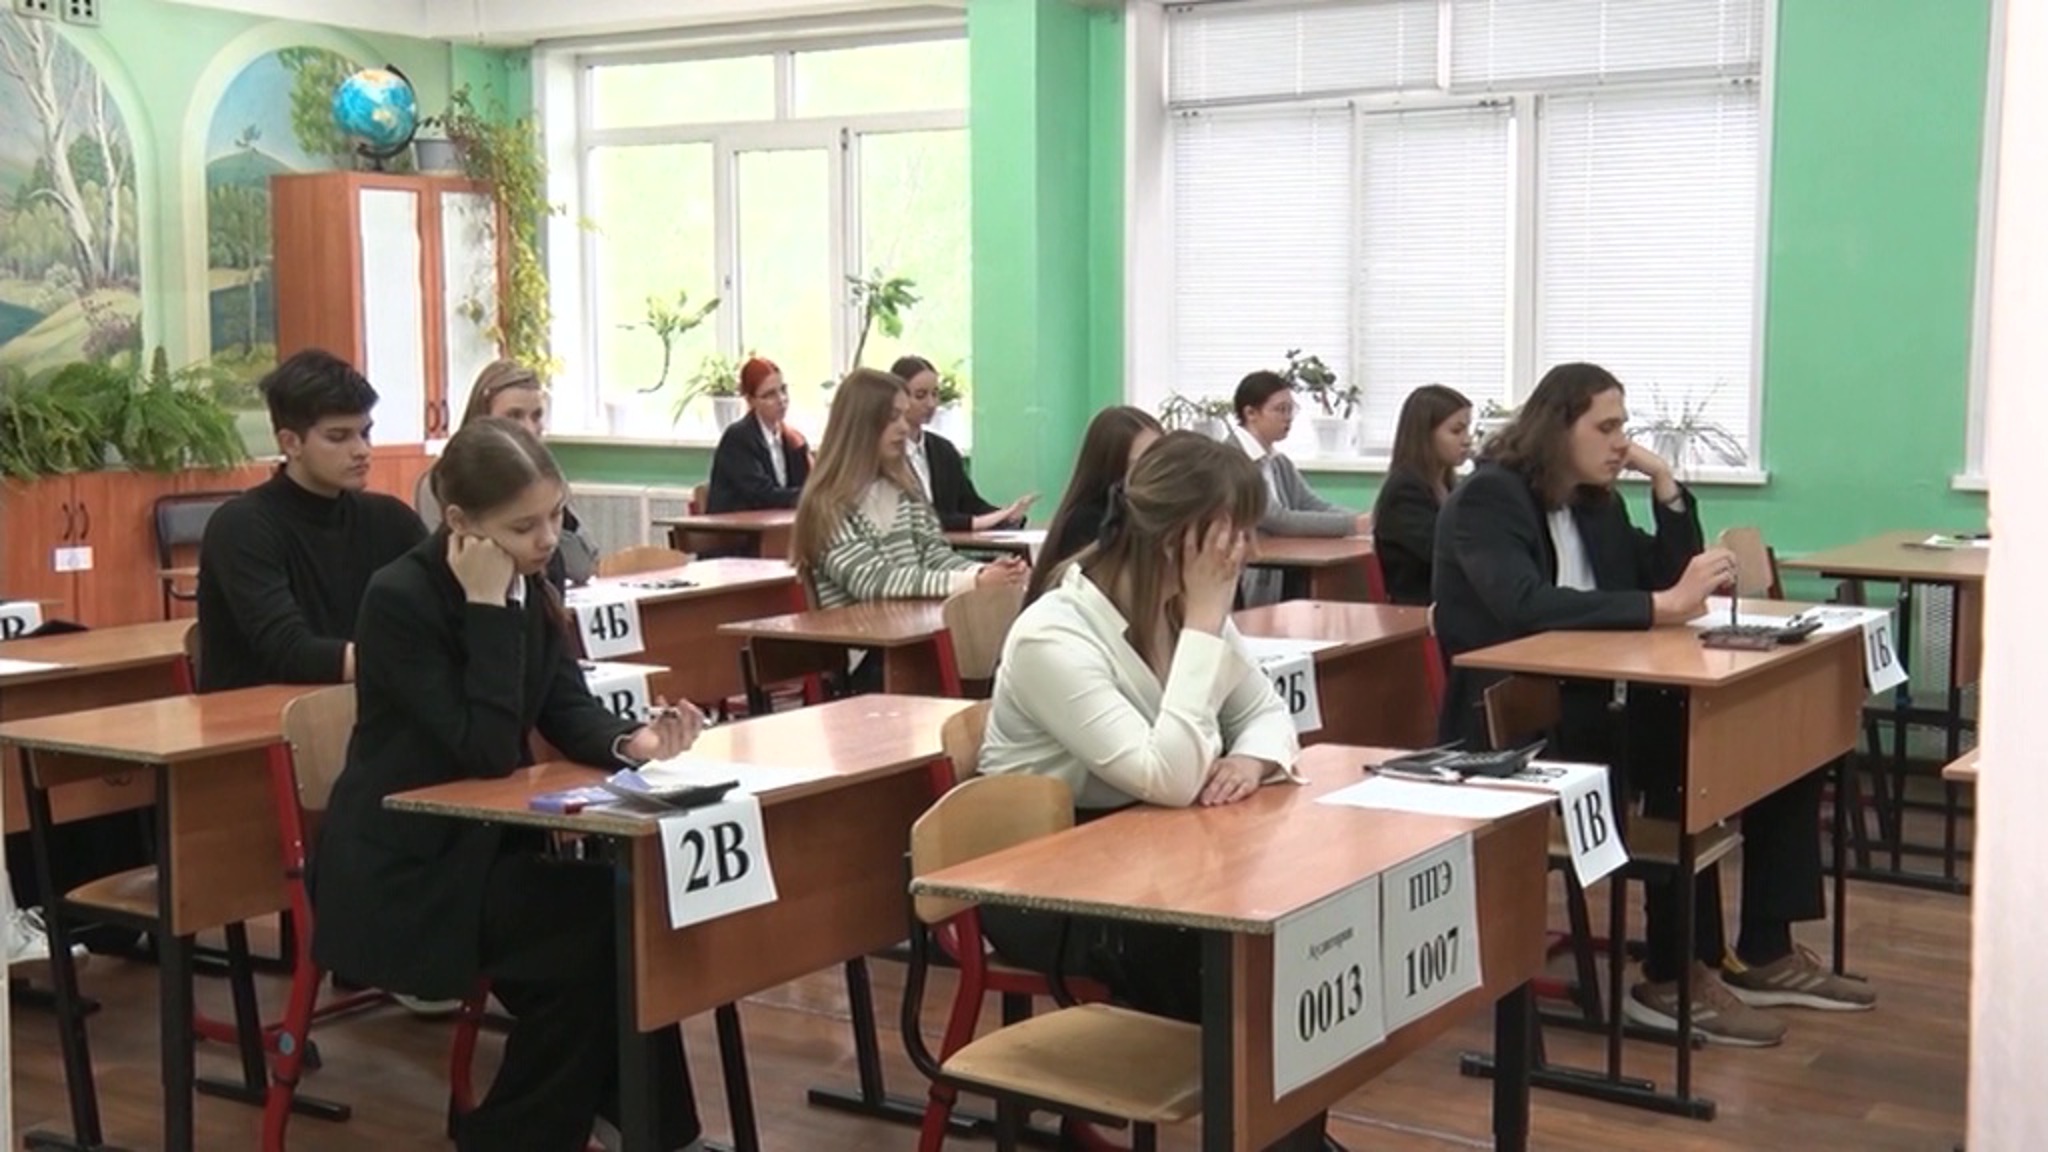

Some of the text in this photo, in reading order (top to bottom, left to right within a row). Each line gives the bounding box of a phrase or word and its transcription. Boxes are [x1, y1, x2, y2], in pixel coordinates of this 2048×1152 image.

[590, 603, 629, 641] 4Б
[1869, 626, 1892, 672] 1Б
[1573, 789, 1607, 855] 1В
[680, 821, 750, 893] 2В
[1409, 860, 1453, 911] ППЭ
[1406, 926, 1459, 998] 1007
[1299, 964, 1363, 1041] 0013
